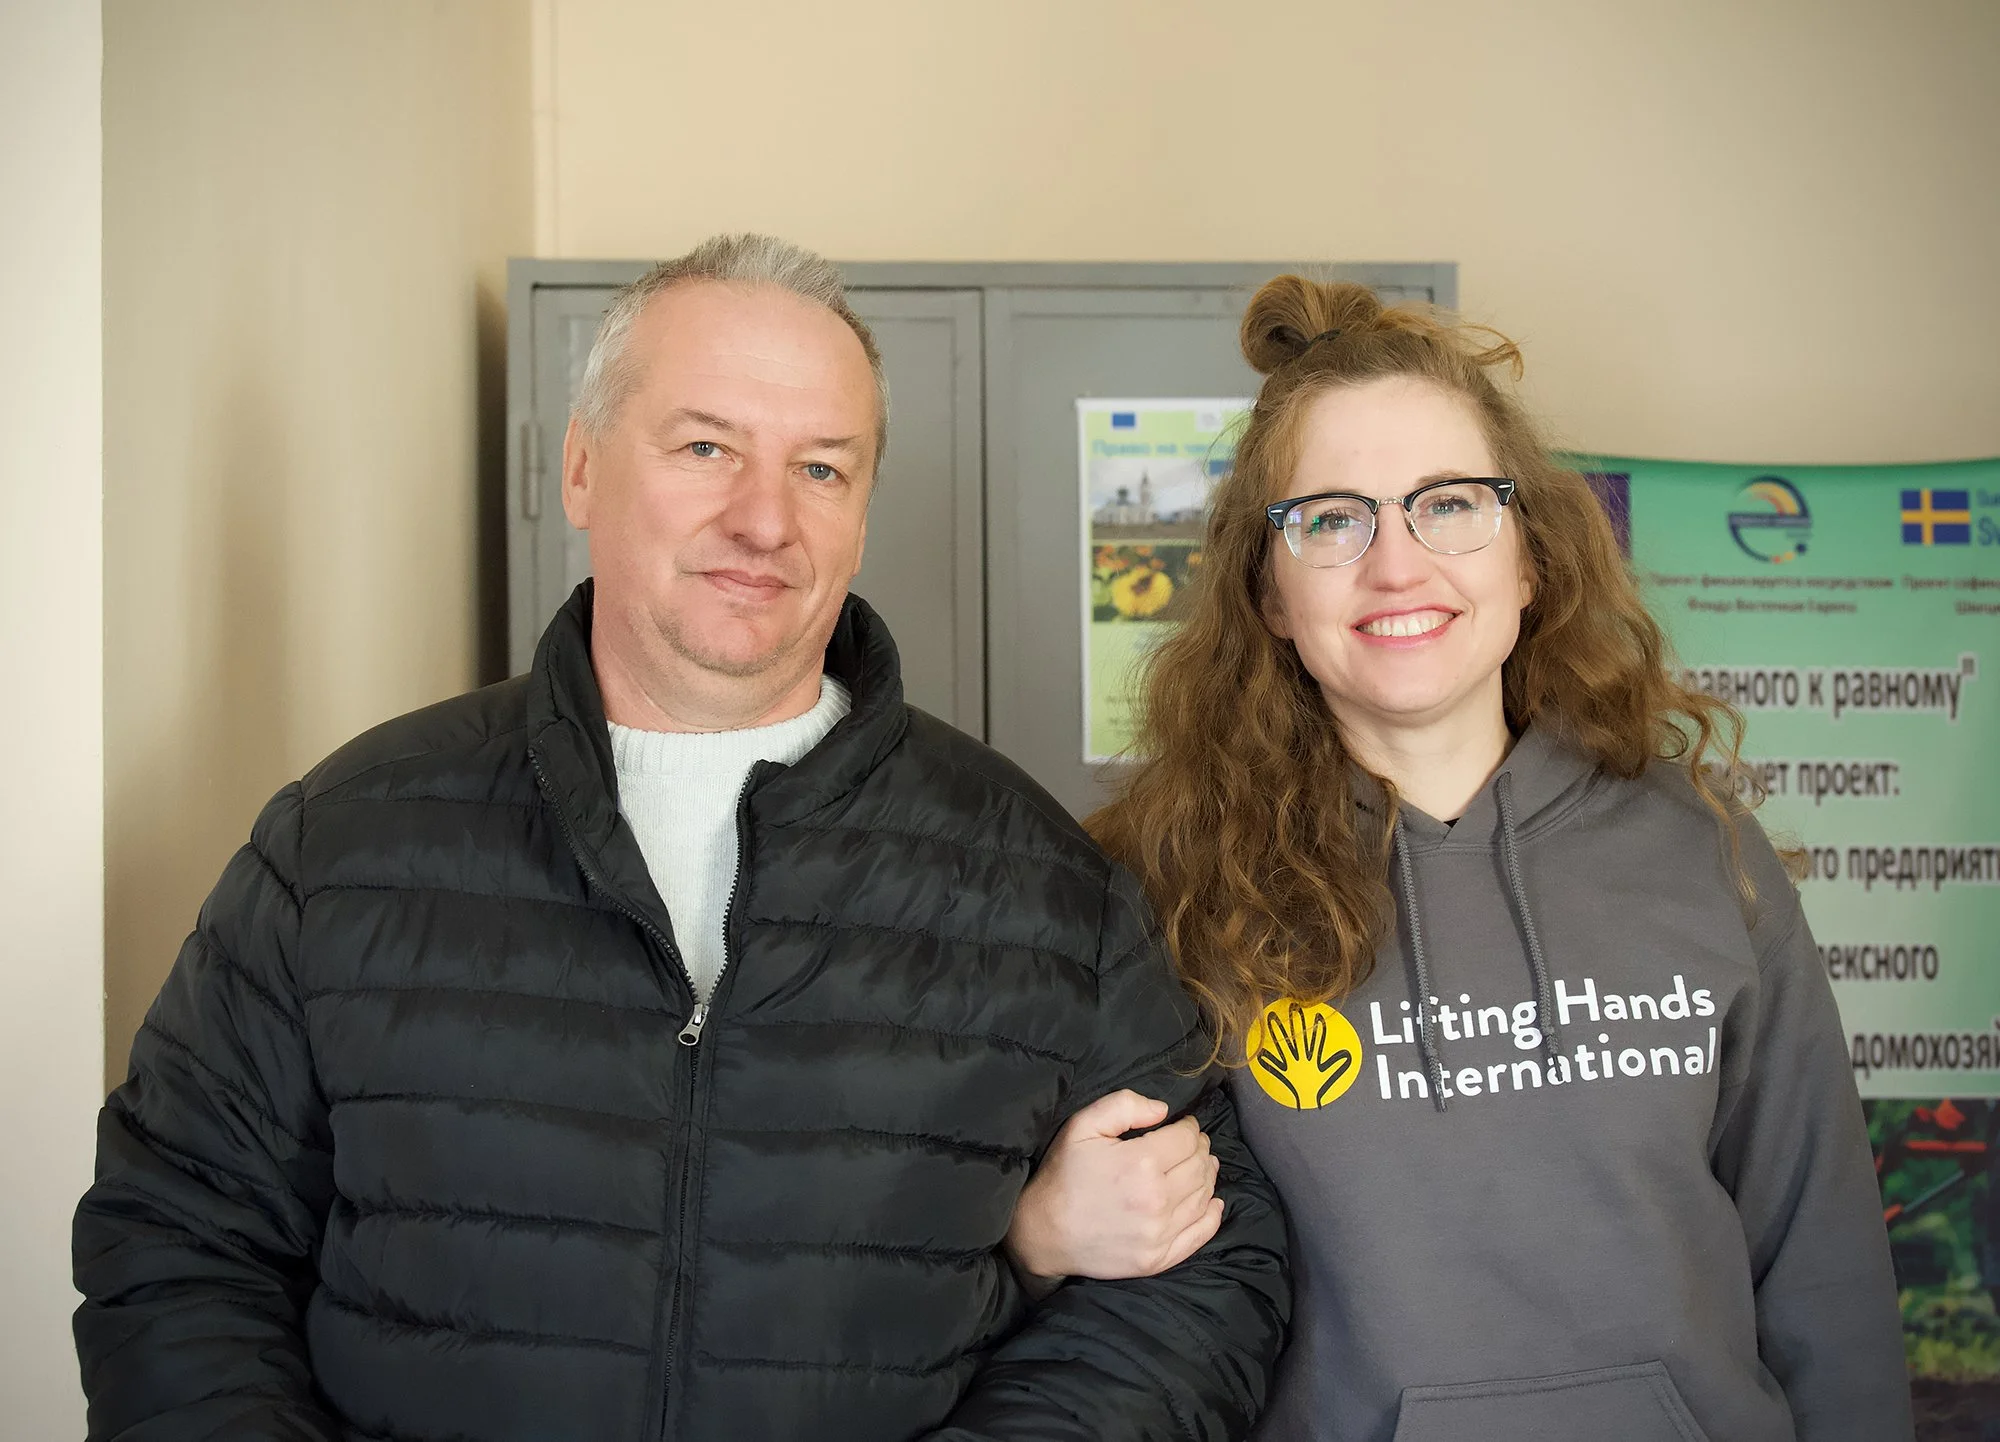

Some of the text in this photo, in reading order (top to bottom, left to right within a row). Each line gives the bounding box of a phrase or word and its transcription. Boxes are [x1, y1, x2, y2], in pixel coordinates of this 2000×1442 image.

[1808, 671, 1824, 706] к
[1798, 762, 1900, 806] проект:
[1848, 846, 2000, 893] предприят
[1818, 944, 1939, 980] ексного
[1553, 974, 1716, 1026] Hands
[1377, 1027, 1717, 1100] International
